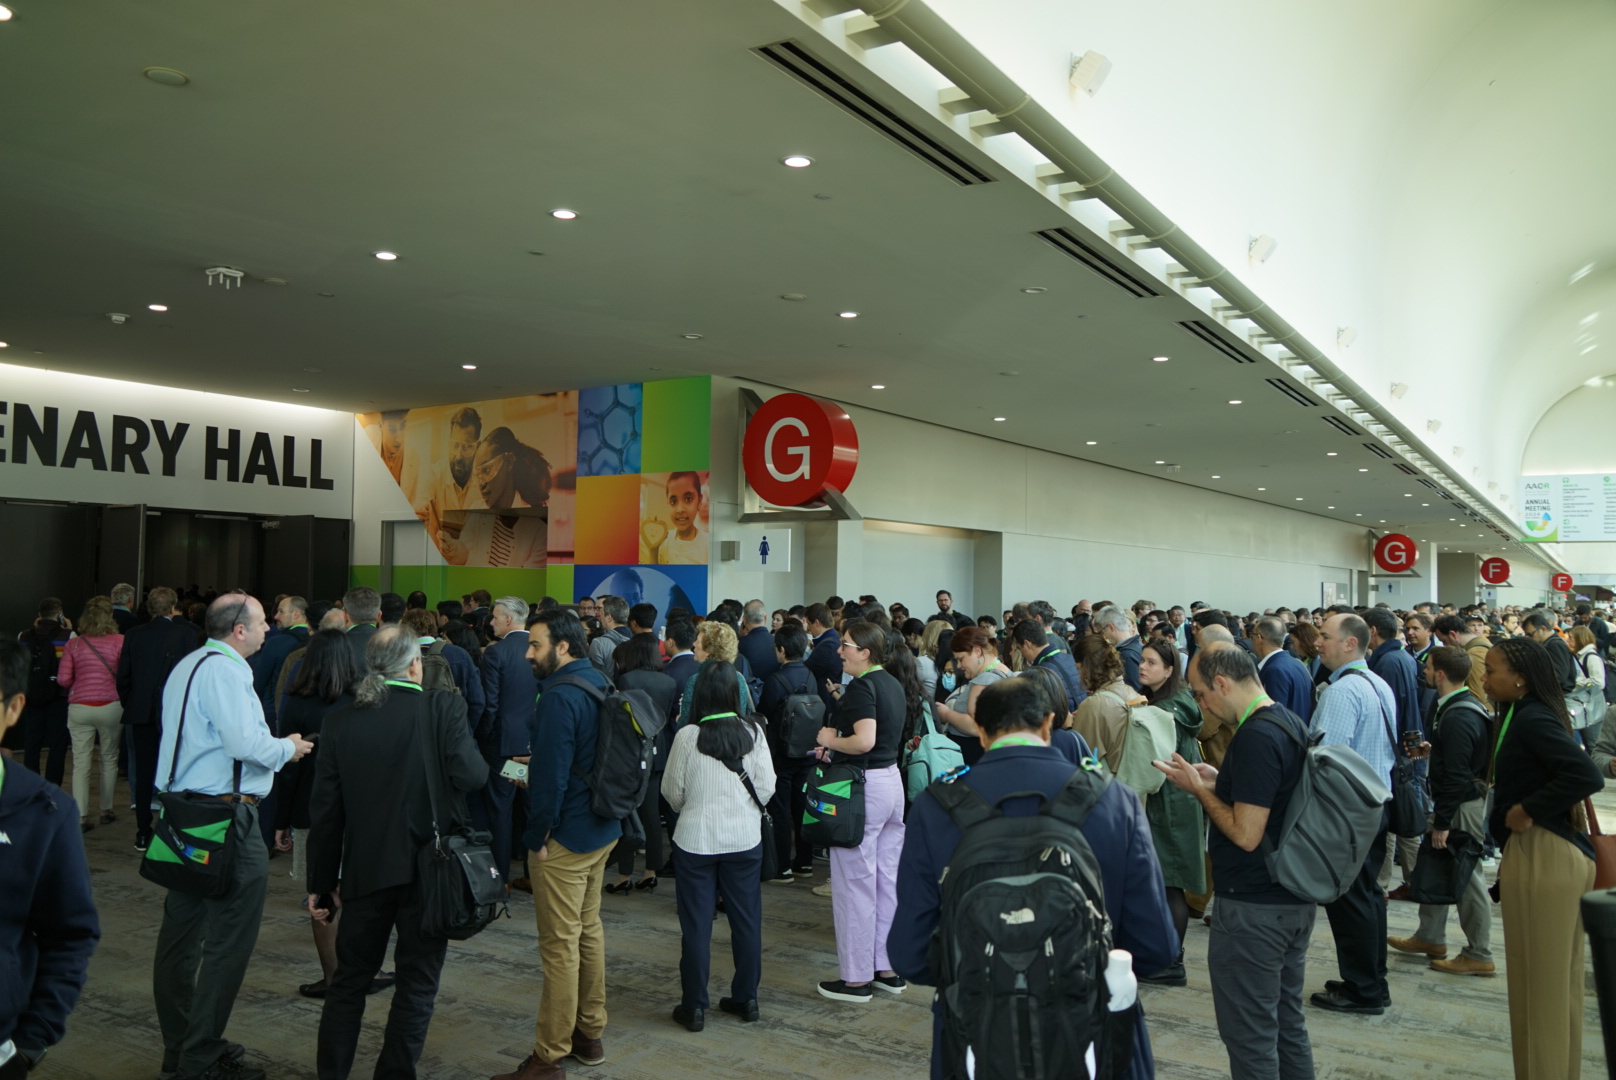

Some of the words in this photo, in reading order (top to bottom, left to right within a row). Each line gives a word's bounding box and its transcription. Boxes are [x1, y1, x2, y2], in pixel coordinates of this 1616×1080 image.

[0, 401, 190, 477] NARY
[204, 425, 334, 490] HALL
[764, 416, 811, 483] G
[1384, 541, 1407, 565] G
[1488, 562, 1503, 579] F
[1557, 576, 1568, 588] F
